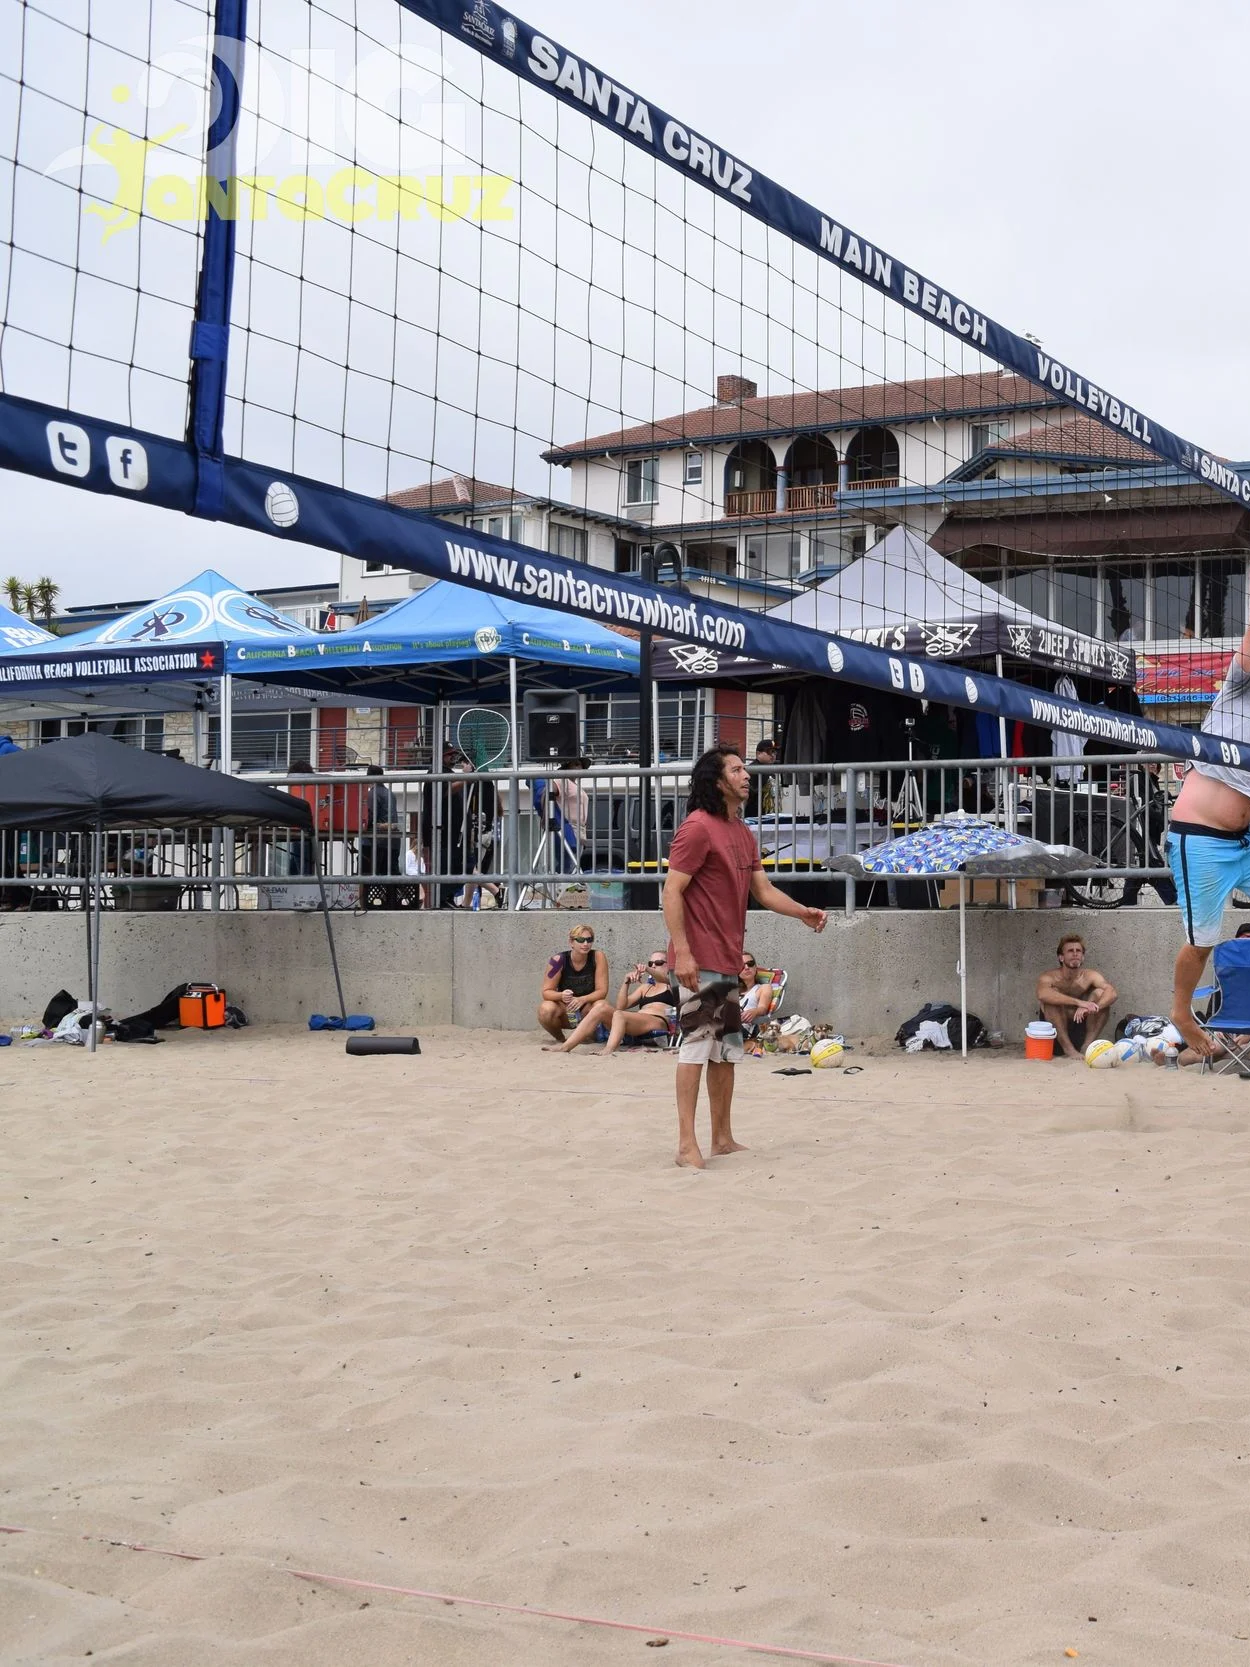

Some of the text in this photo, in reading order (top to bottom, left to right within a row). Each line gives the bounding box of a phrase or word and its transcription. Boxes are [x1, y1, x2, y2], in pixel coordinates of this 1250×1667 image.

[528, 35, 653, 143] SANTA
[663, 120, 752, 203] CRUZ
[820, 217, 892, 288] MAIN
[903, 270, 987, 346] BEACH
[1037, 353, 1152, 444] VOLLEYBALL
[1200, 455, 1240, 496] SANTA
[446, 540, 746, 649] www.santacruzwharf.com
[44, 662, 73, 679] BEACH
[75, 657, 132, 676] VOLLEYBALL
[134, 652, 197, 673] ASSOCIATION
[237, 647, 286, 660] CALIFORNIA
[287, 645, 315, 658] BEACH
[317, 643, 360, 656] VOLLEYBALL
[1072, 638, 1106, 668] SPORTS
[1030, 698, 1158, 748] www.santacruzwharf.com
